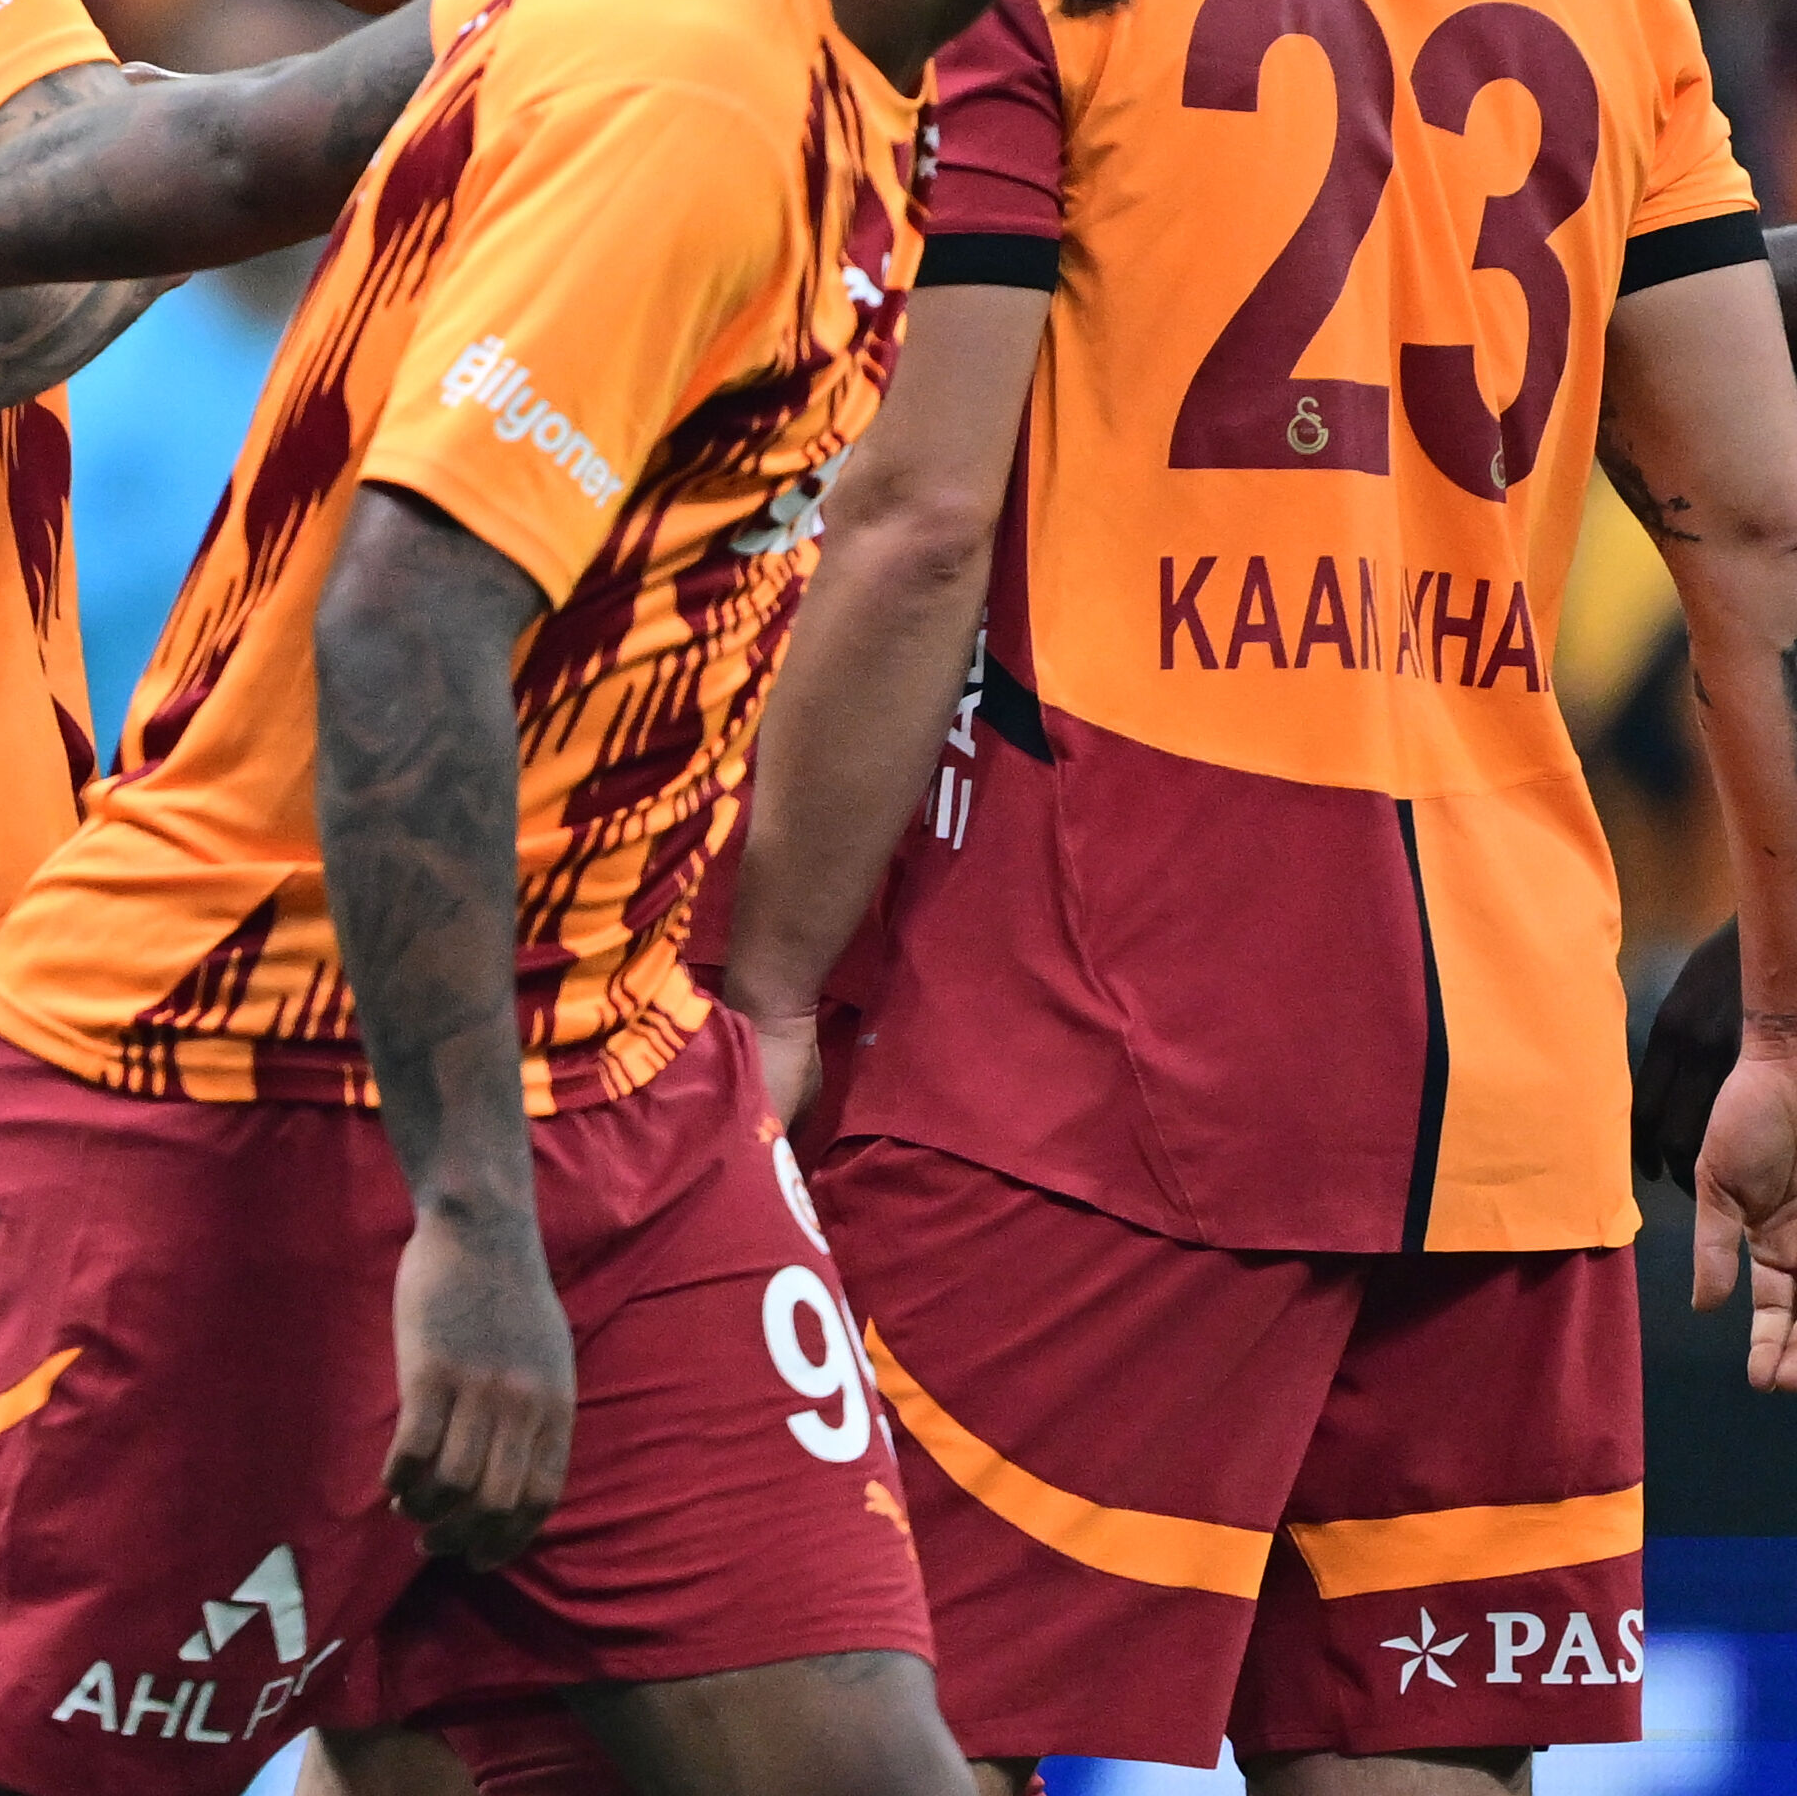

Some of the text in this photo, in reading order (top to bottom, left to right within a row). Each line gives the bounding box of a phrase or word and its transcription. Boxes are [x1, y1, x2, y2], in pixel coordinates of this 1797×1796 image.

[440, 334, 623, 508] Bilyoner
[1160, 555, 1382, 672] KAAN
[761, 1264, 898, 1464] 9
